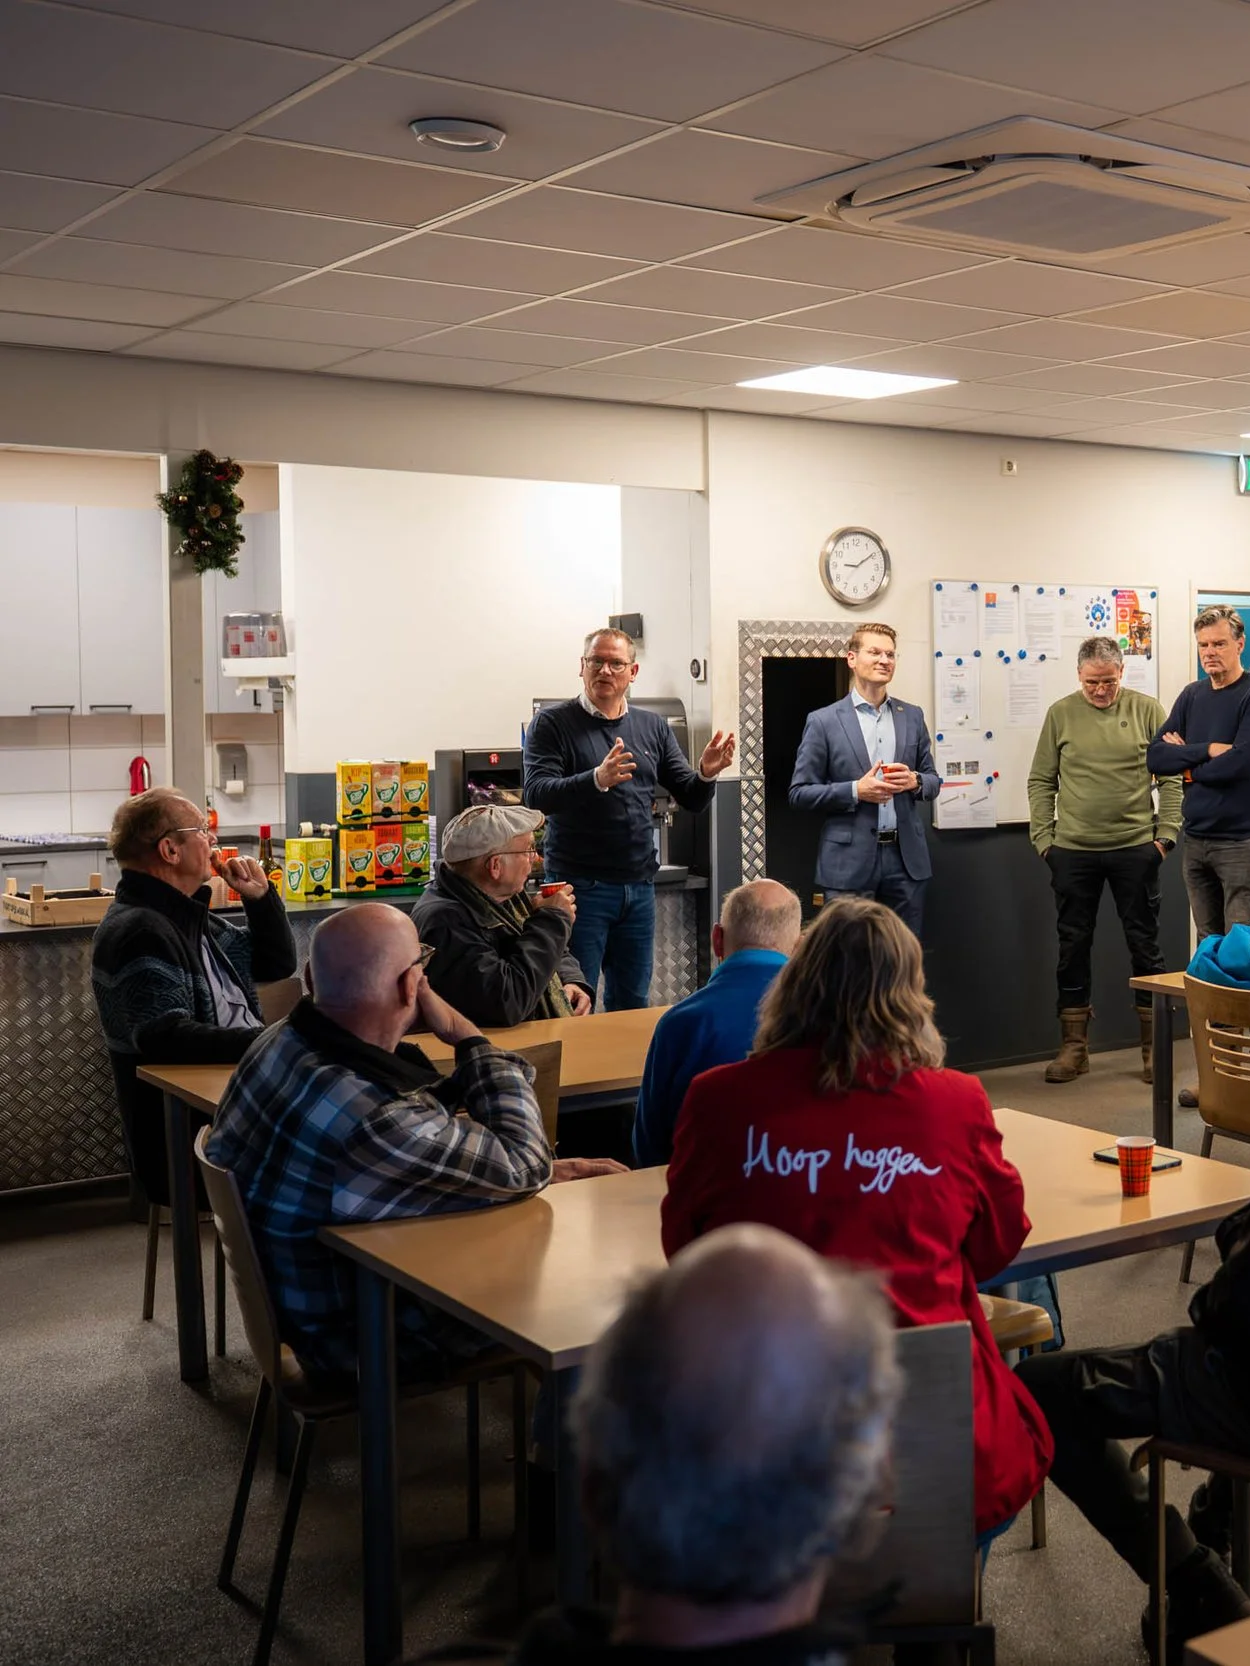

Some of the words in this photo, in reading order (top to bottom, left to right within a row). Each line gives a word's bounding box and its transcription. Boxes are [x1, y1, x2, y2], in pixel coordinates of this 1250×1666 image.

[842, 542, 849, 550] 11
[852, 538, 860, 547] 12
[871, 552, 877, 560] 2
[832, 561, 837, 569] 9
[874, 563, 879, 571] 3
[835, 574, 841, 582] 8
[863, 583, 868, 591] 5
[742, 1125, 831, 1194] Hoop
[844, 1132, 943, 1194] heggen
